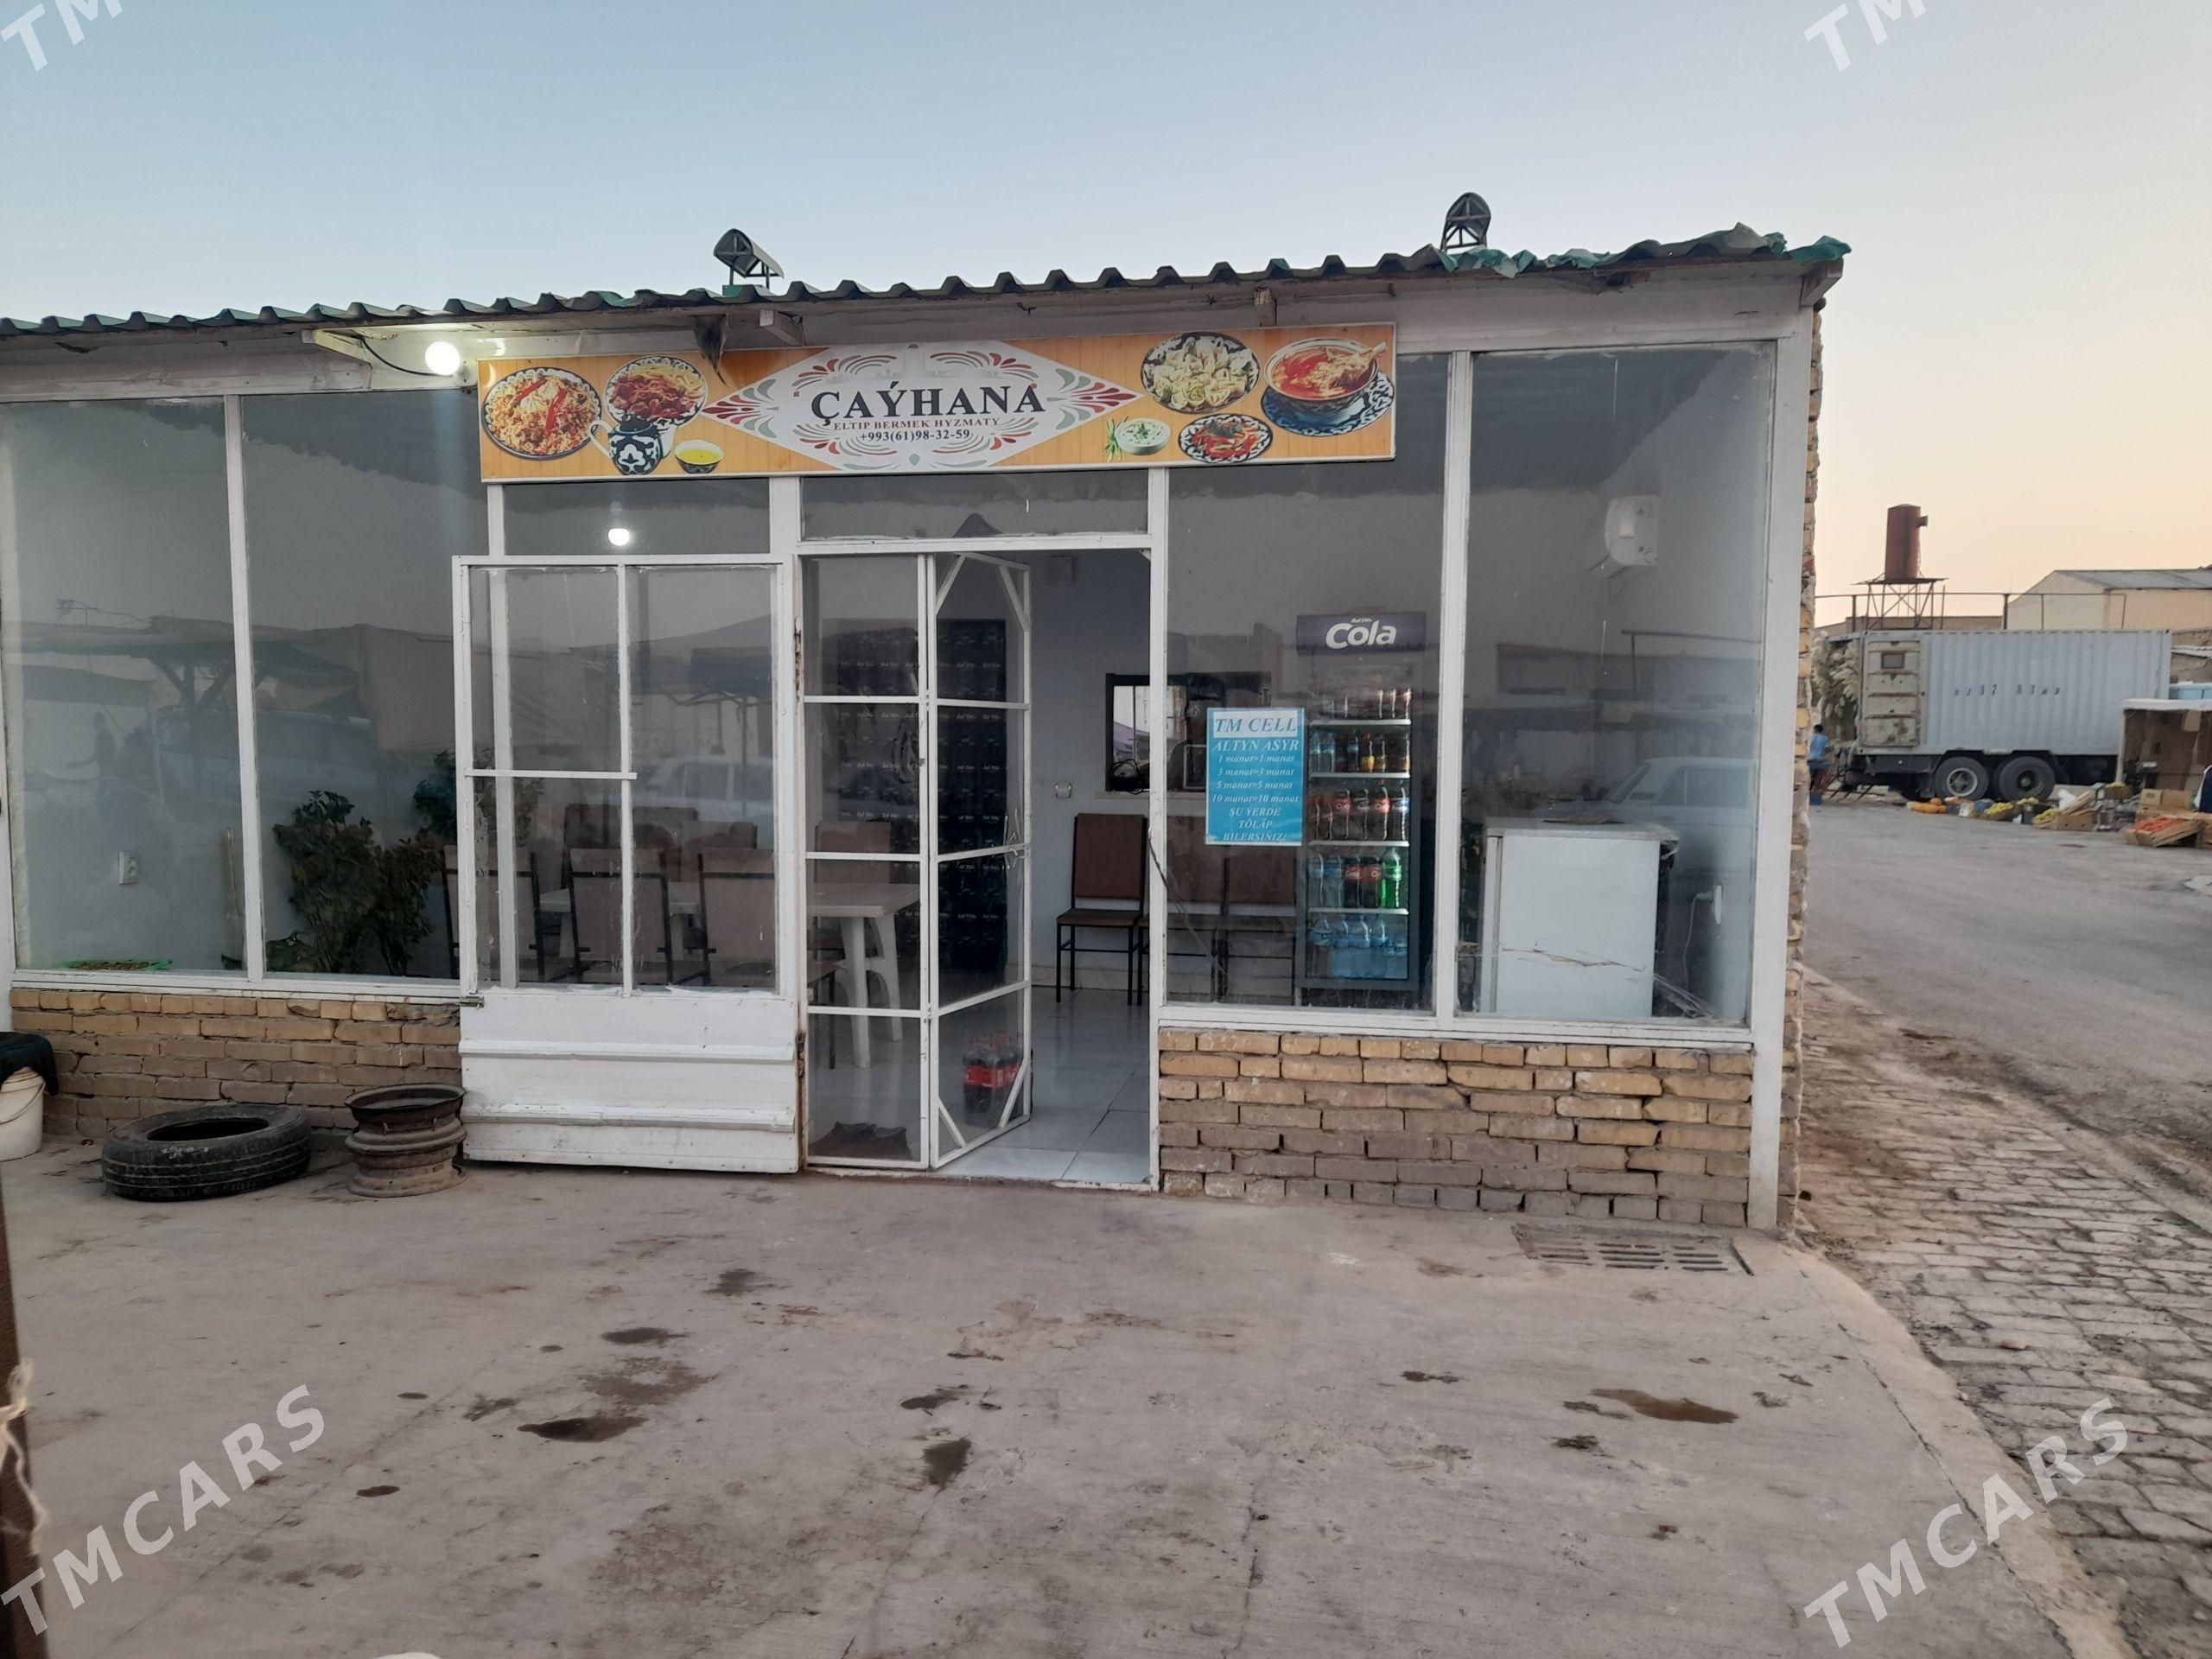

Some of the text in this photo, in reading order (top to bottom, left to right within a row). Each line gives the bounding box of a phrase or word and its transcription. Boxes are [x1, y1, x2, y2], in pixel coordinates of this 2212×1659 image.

[810, 381, 1046, 426] ÇAÝHANA
[834, 417, 1001, 431] ELTIP BERMEK HYZMATY
[860, 429, 970, 442] +993(61)98-32-59
[1325, 620, 1397, 650] Cola
[1215, 717, 1298, 733] TM CELL
[1211, 739, 1300, 752] ALTYN ASYR
[1266, 754, 1294, 763] manat
[1212, 794, 1223, 803] 10
